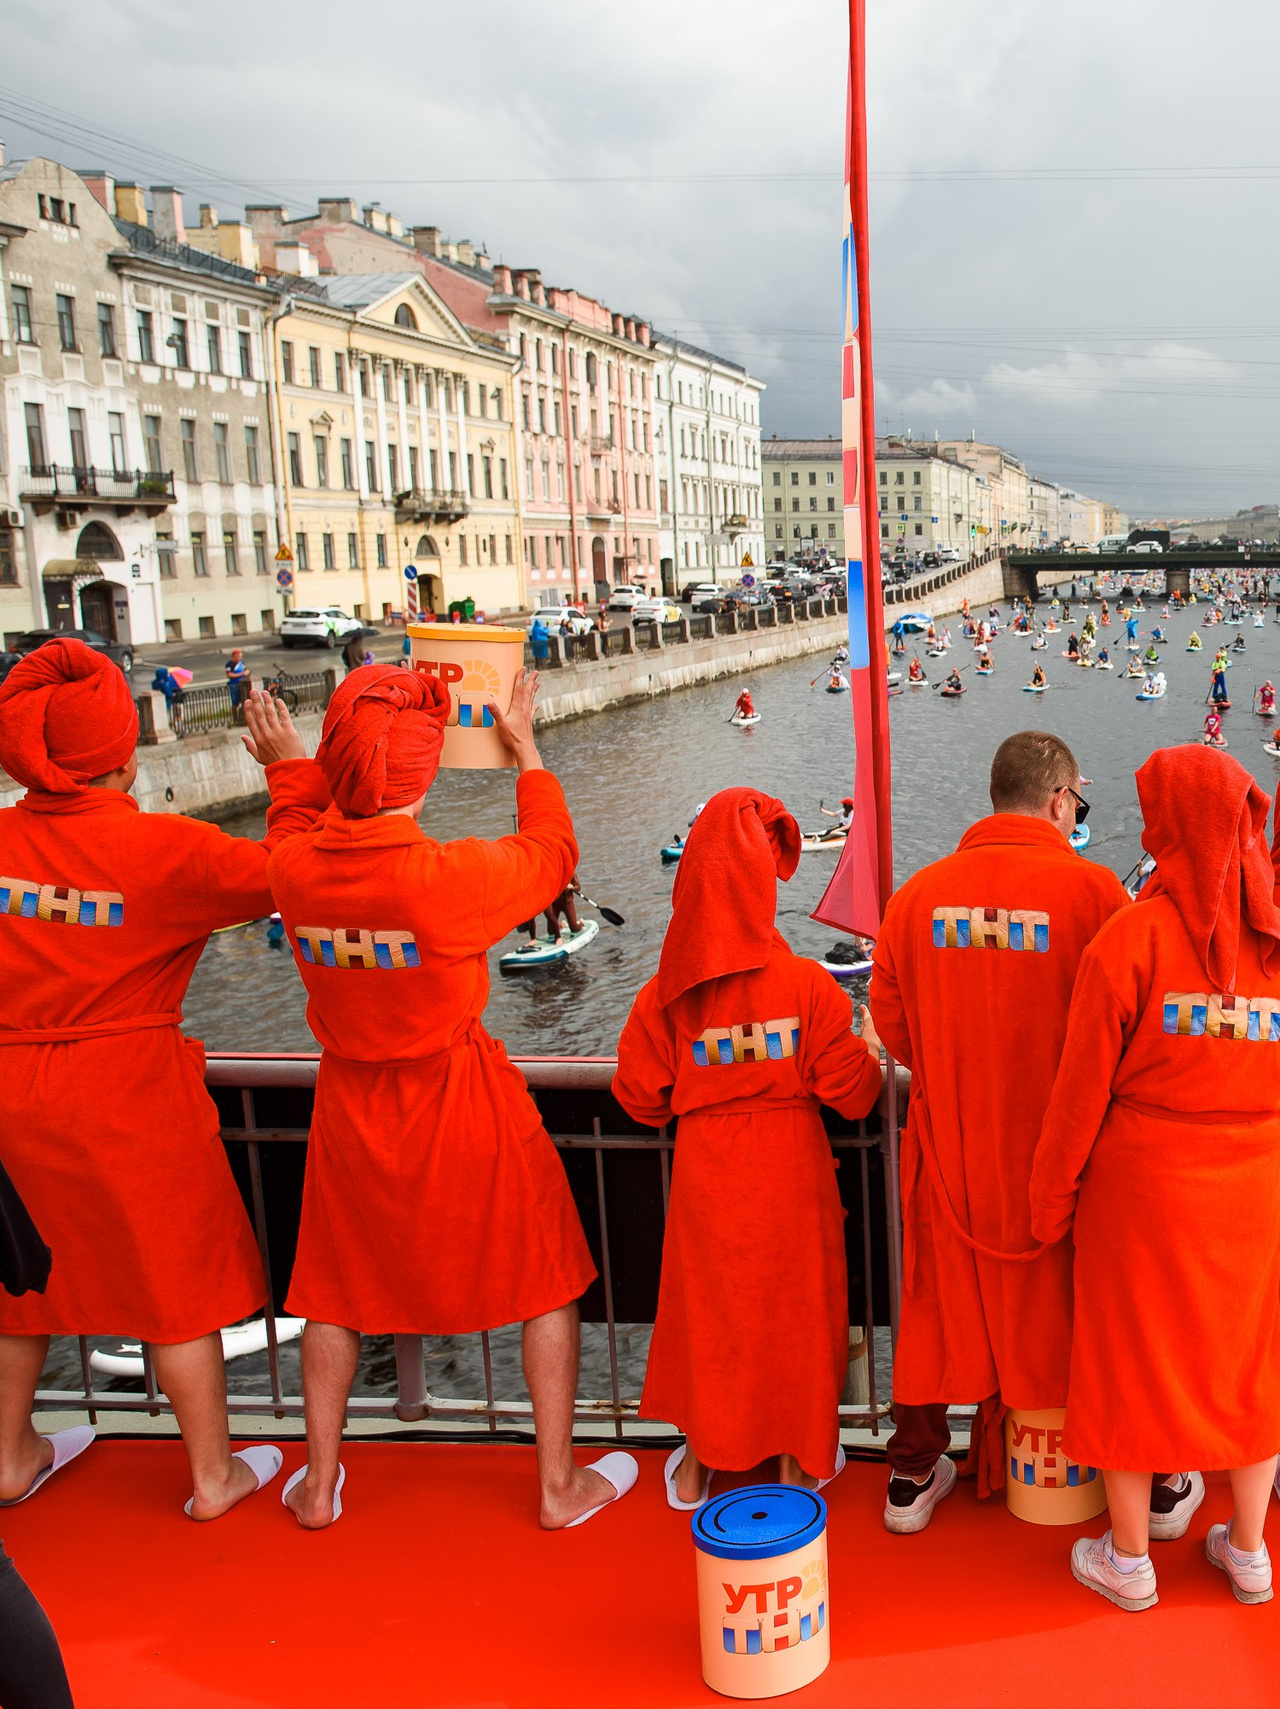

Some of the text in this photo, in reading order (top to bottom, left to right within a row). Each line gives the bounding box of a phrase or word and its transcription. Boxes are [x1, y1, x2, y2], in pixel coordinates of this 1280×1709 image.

[0, 875, 125, 927] ТНТ
[294, 925, 422, 970] ТНТ
[932, 906, 1051, 953] ТНТ
[692, 1015, 800, 1067] ТНТ
[722, 1592, 826, 1655] ТНТ
